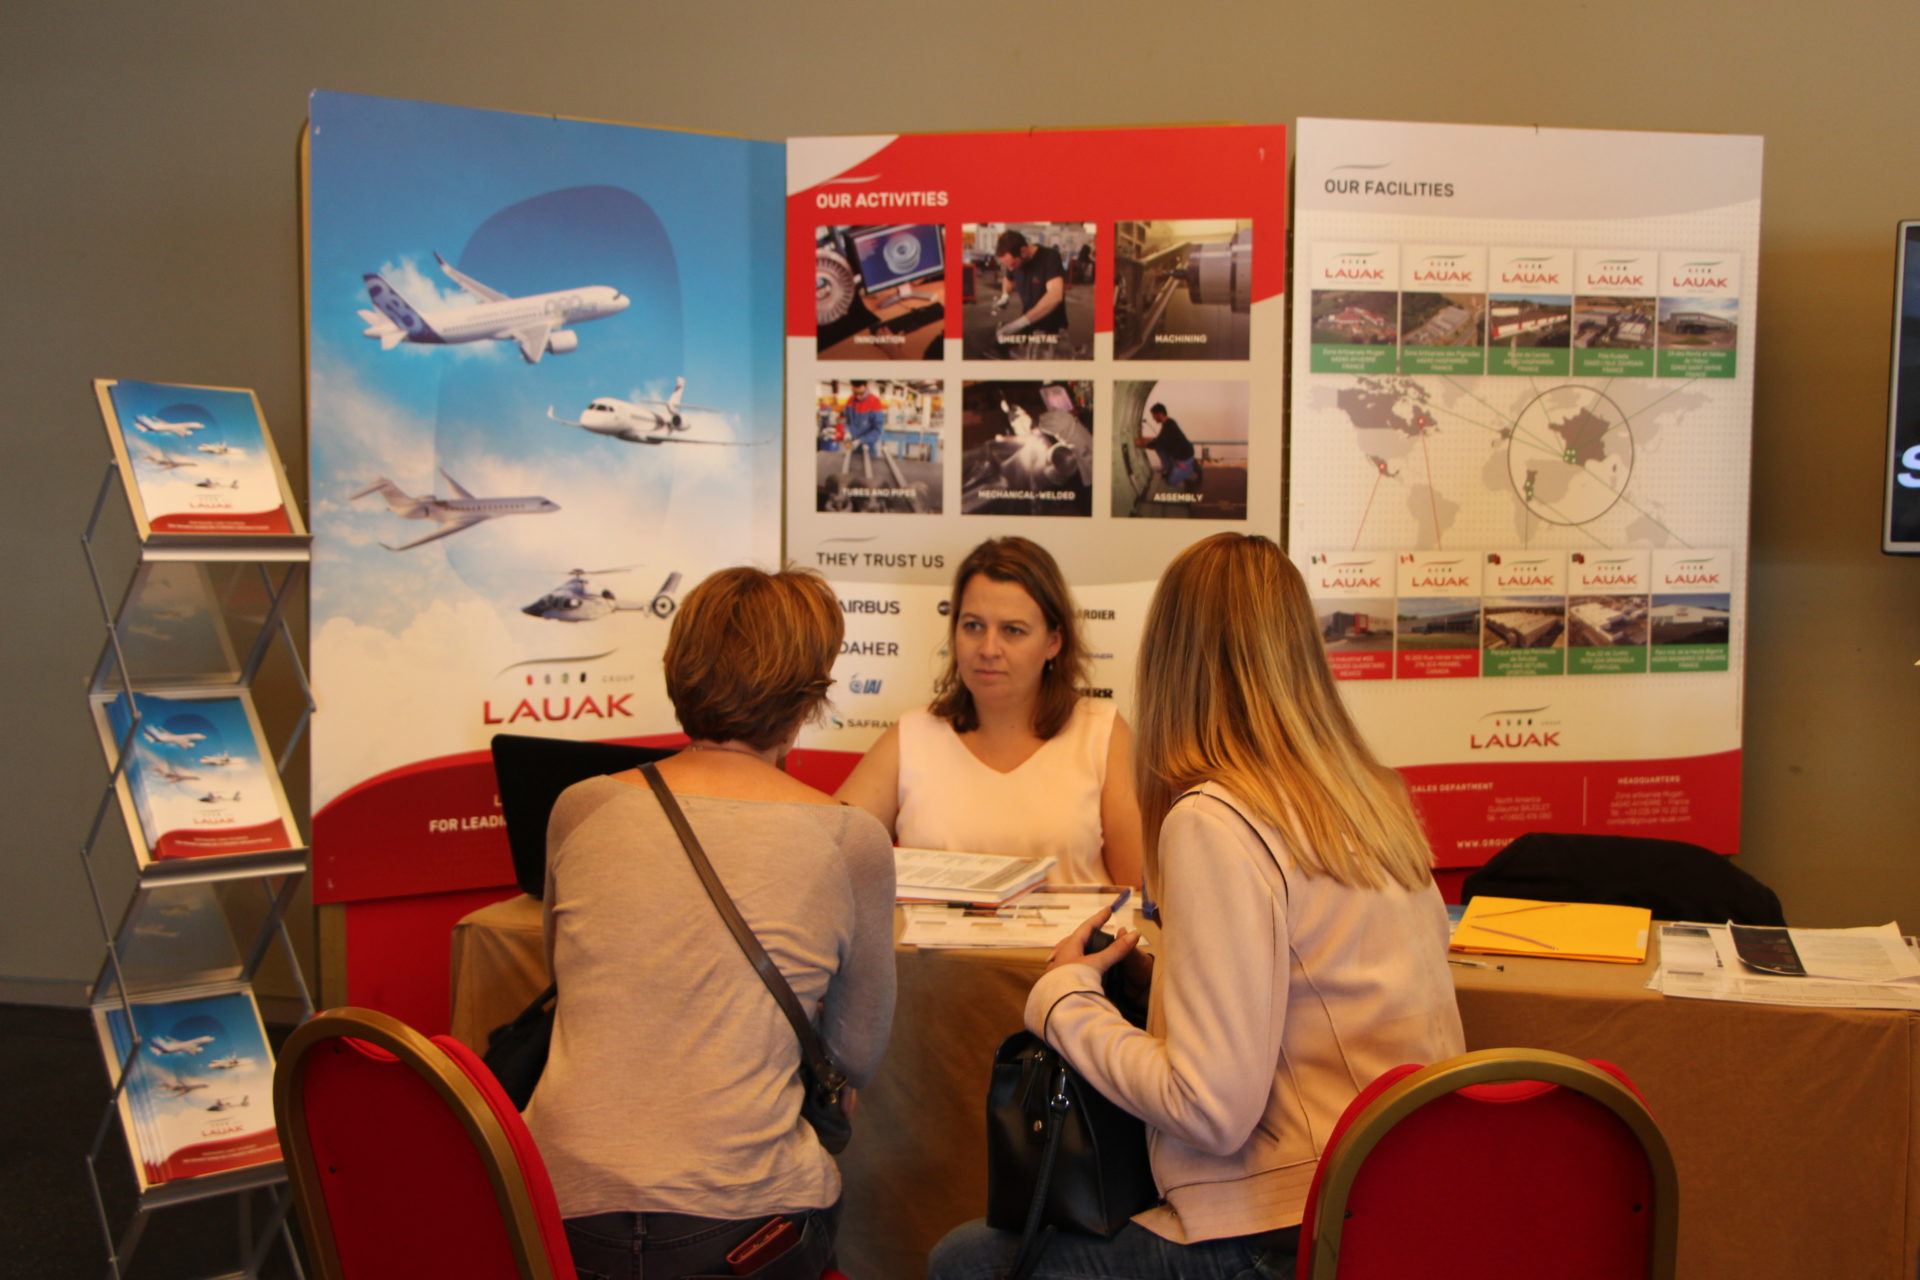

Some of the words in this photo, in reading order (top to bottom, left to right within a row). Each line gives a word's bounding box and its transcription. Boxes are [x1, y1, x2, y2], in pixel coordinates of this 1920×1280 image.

[1324, 180, 1359, 194] OUR
[1364, 181, 1454, 197] FACILITIES
[817, 193, 851, 209] OUR
[855, 190, 949, 208] ACTIVITIES
[1324, 267, 1385, 280] LAUAK
[1413, 270, 1472, 282] LAUAK
[1502, 272, 1559, 284] LAUAK
[1587, 275, 1643, 286] LAUAK
[1672, 277, 1727, 288] LAUAK
[854, 334, 906, 344] INNOVATION
[1155, 333, 1207, 345] MACHINING
[978, 490, 1076, 501] MECHANICAL-WELDED
[1153, 492, 1203, 503] ASSEMBLY
[816, 552, 859, 567] THEY
[864, 553, 917, 568] TRUST
[922, 555, 944, 568] US
[1322, 577, 1381, 588] LAUAK
[1412, 576, 1469, 587] LAUAK
[1498, 575, 1554, 586] LAUAK
[1582, 574, 1637, 585] LAUAK
[1665, 573, 1720, 584] LAUAK
[483, 693, 635, 725] LAUAK
[1470, 730, 1560, 749] LAUAK
[1617, 775, 1681, 786] HEADQUARTERS
[1439, 782, 1494, 792] DEPARTMENT
[430, 819, 458, 832] FOR
[462, 814, 507, 830] LEADI
